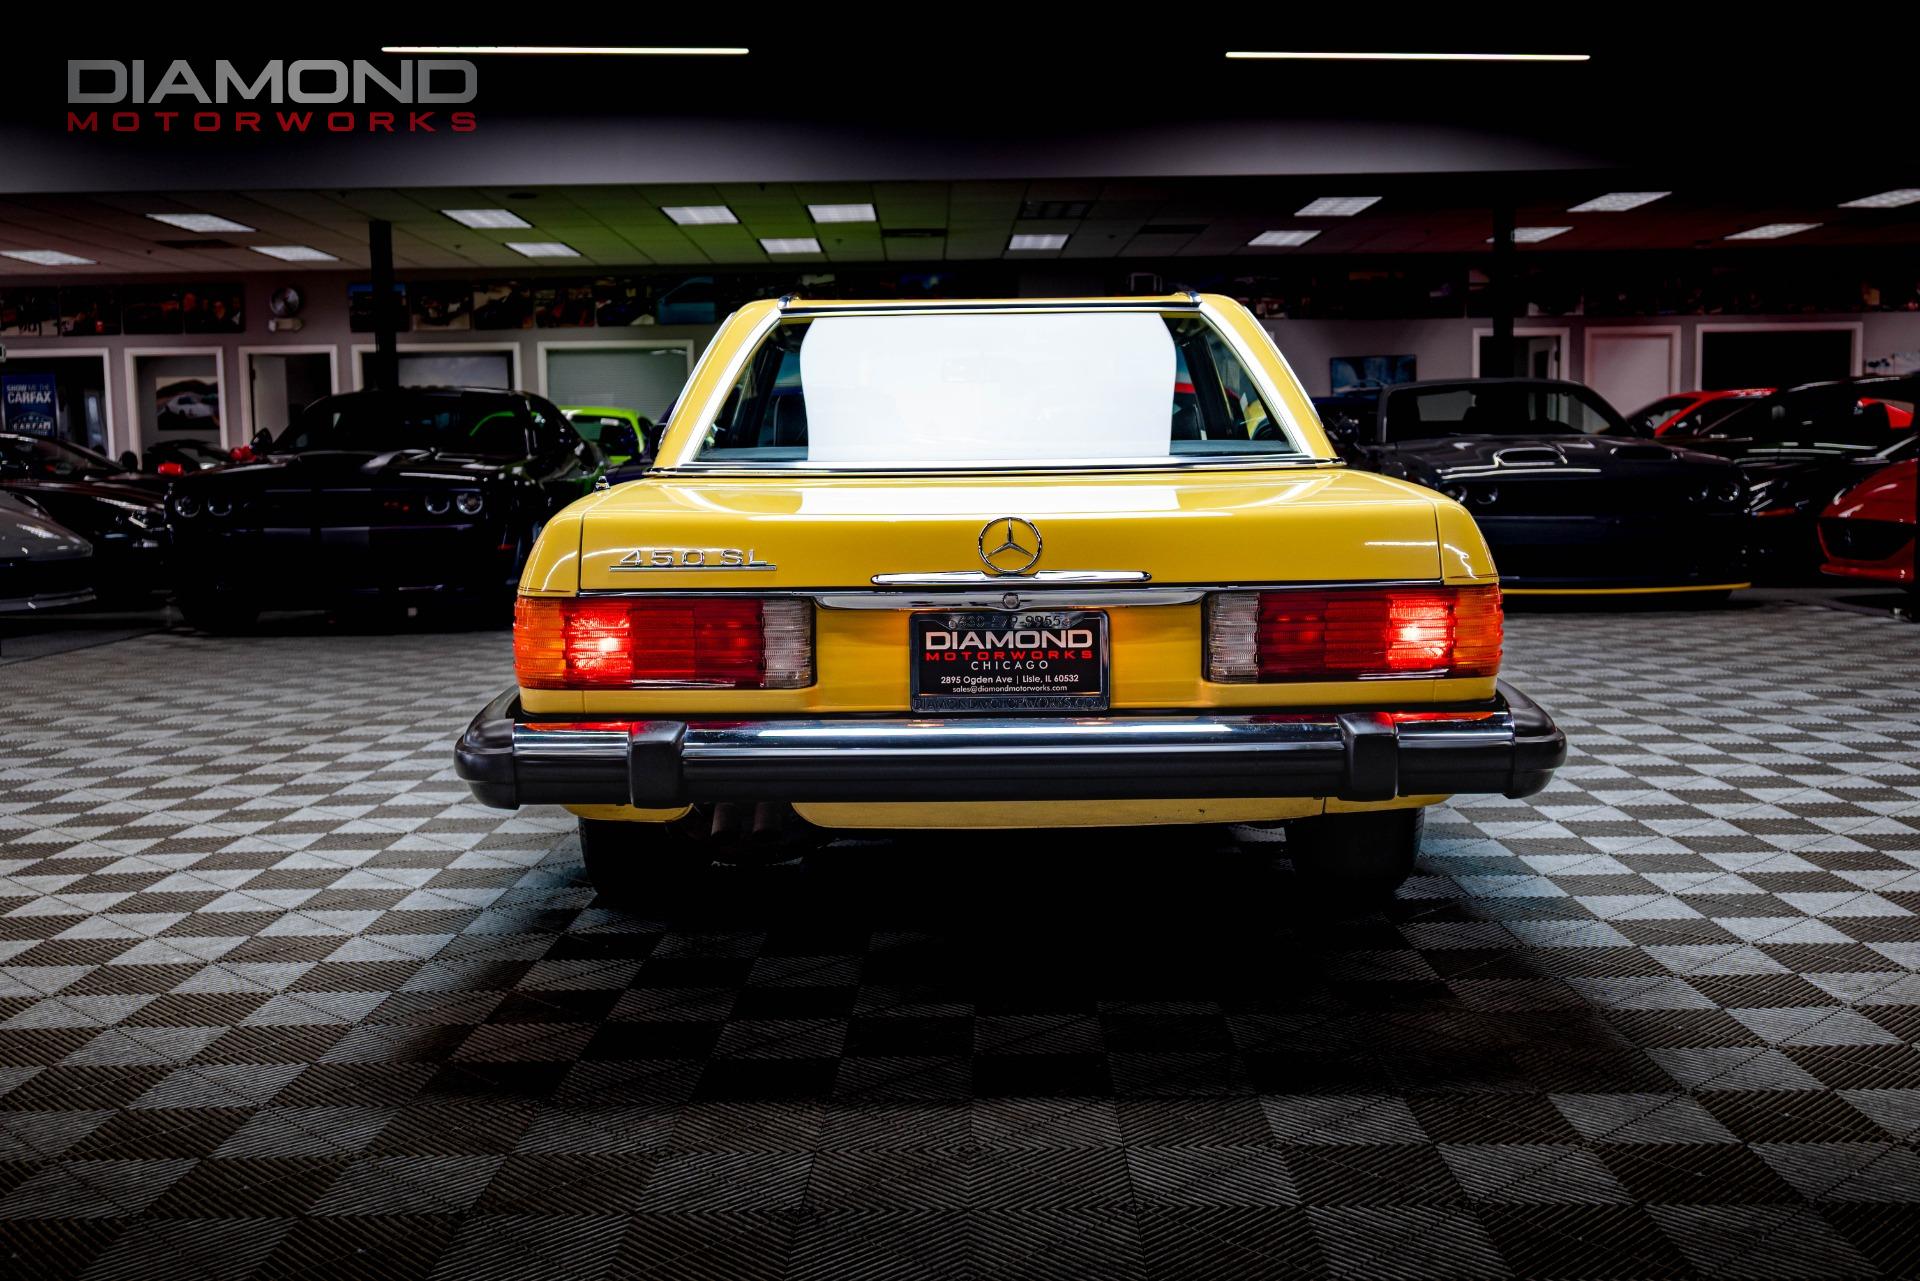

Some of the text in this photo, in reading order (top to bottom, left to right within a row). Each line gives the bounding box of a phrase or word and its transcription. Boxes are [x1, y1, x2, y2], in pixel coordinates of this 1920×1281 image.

[7, 391, 52, 404] CARFAX
[620, 549, 768, 566] 450 SL
[925, 630, 1093, 650] DIAMOND
[925, 650, 1093, 661] MOTORWORKS
[971, 661, 1049, 671] CHICAGO
[941, 676, 961, 684] 2895
[963, 676, 993, 685] Ogden
[995, 676, 1013, 684] Ave
[1022, 675, 1043, 684] Lisle,
[1045, 675, 1052, 683] IL
[1053, 674, 1079, 683] 60532
[952, 684, 1068, 693] sales@diamondmotorworks.com
